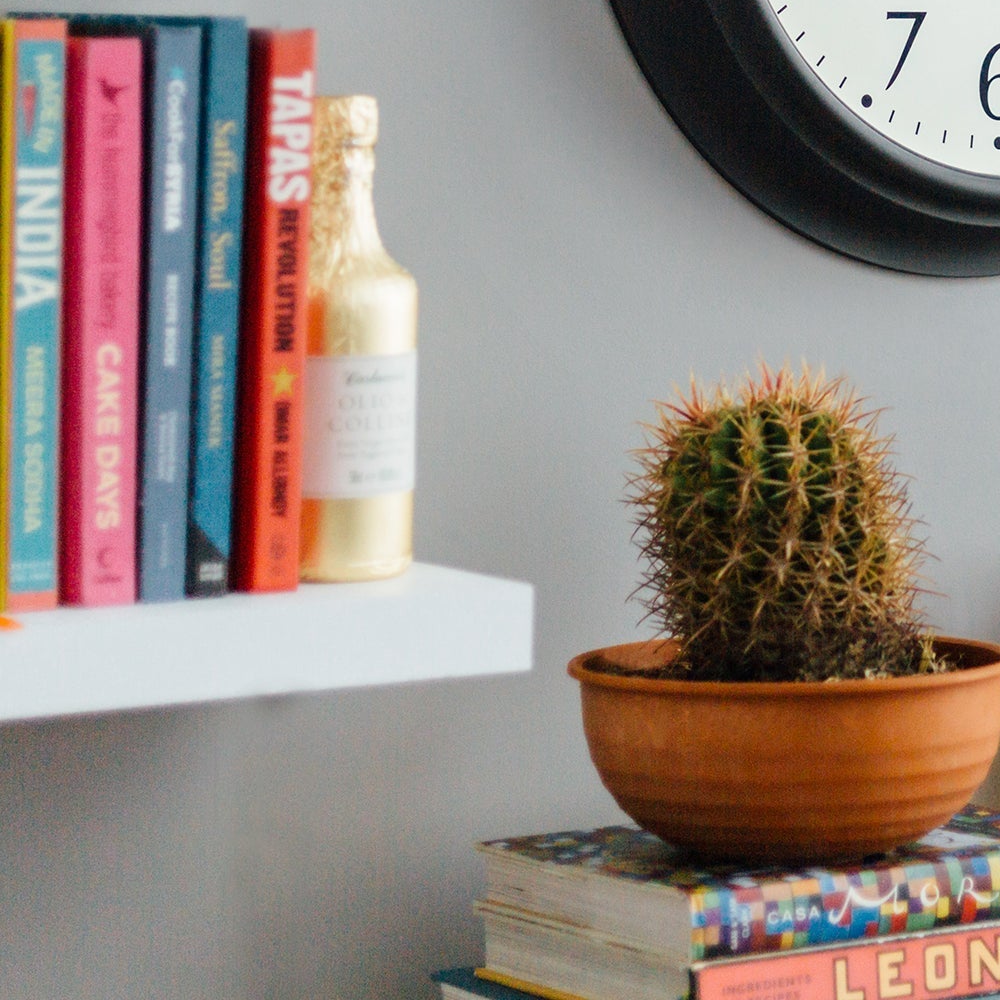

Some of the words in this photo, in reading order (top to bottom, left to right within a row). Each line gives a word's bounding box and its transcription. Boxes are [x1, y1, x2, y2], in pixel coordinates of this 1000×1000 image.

[885, 11, 927, 91] 7
[268, 71, 313, 203] TAPAS
[15, 167, 60, 308] INDIA
[209, 231, 236, 290] Soul
[274, 208, 300, 353] REVOLUTION
[26, 345, 45, 436] MEERA
[97, 344, 122, 435] CAKE
[24, 443, 43, 533] SODHA
[96, 446, 121, 530] DAYS
[767, 906, 821, 925] CASA
